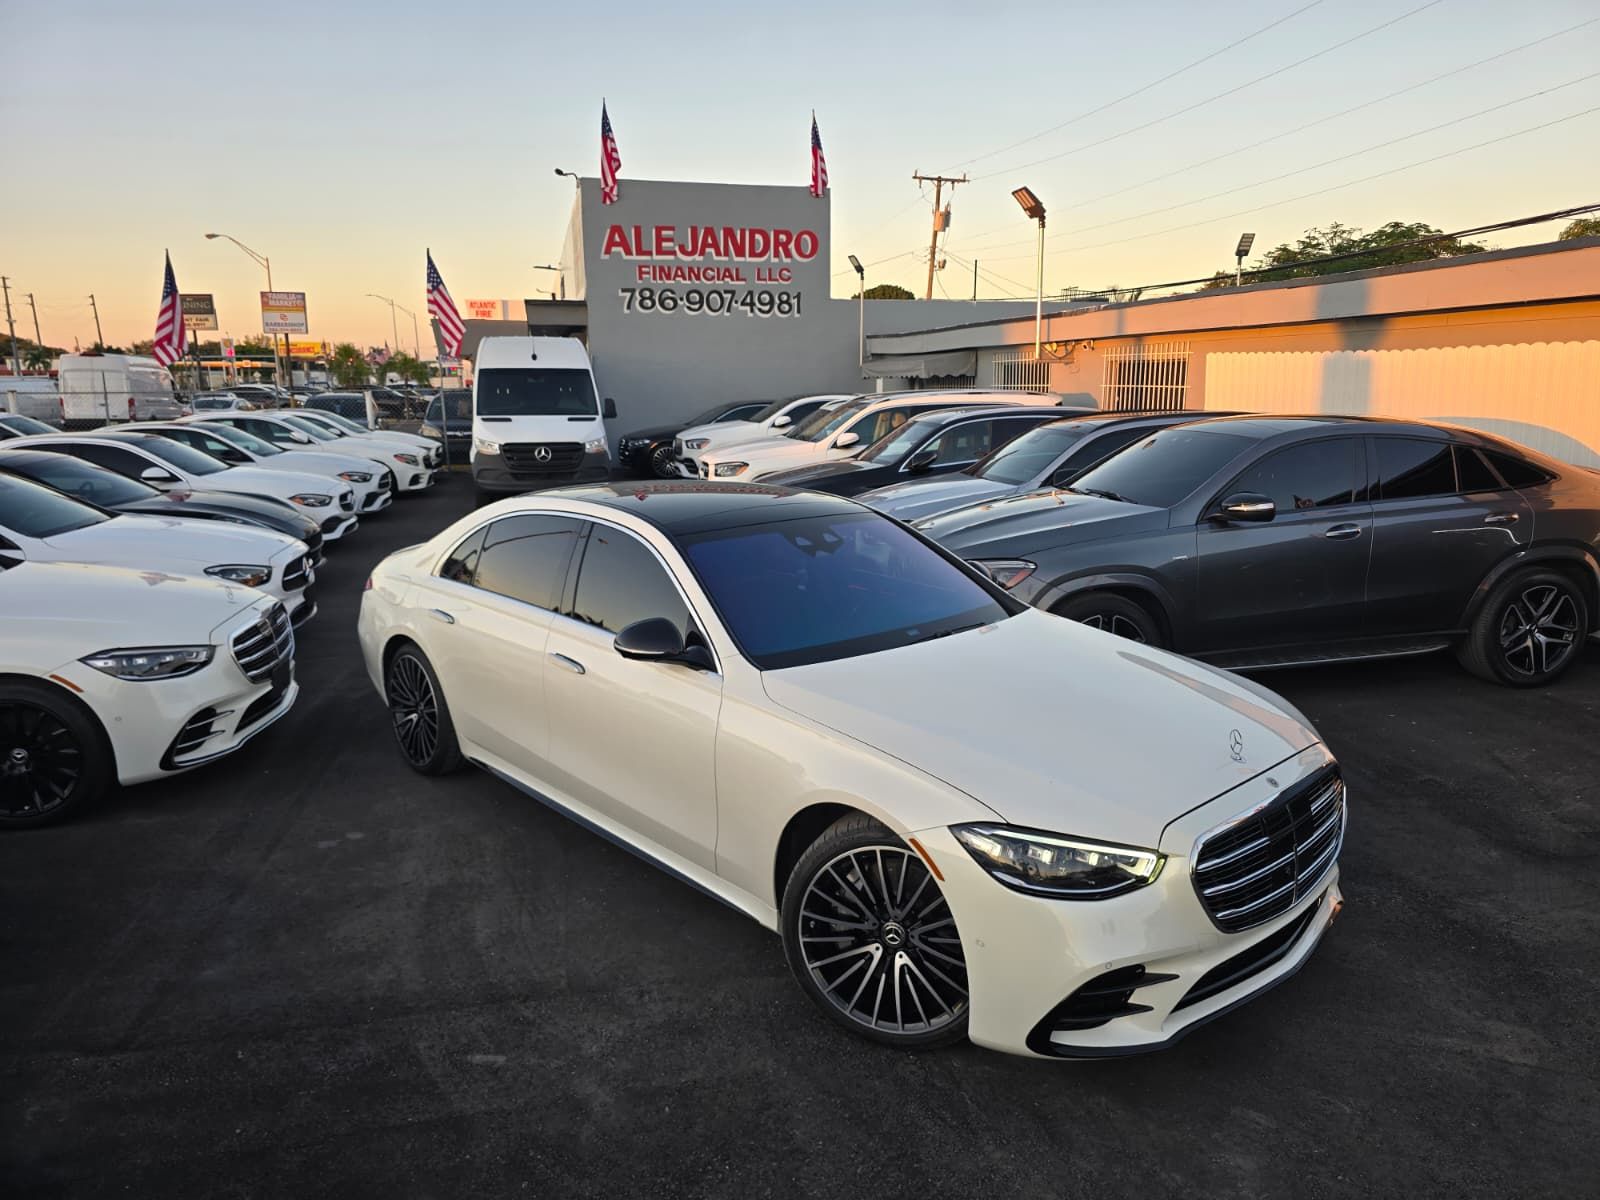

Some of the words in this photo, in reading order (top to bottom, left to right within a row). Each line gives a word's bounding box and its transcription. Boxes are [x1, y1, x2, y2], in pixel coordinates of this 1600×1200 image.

[600, 224, 819, 262] ALEJANDRO
[637, 265, 747, 285] FINANCIAL
[755, 267, 793, 284] LLC
[469, 301, 496, 309] ATLANTIC
[475, 310, 492, 318] FIRE
